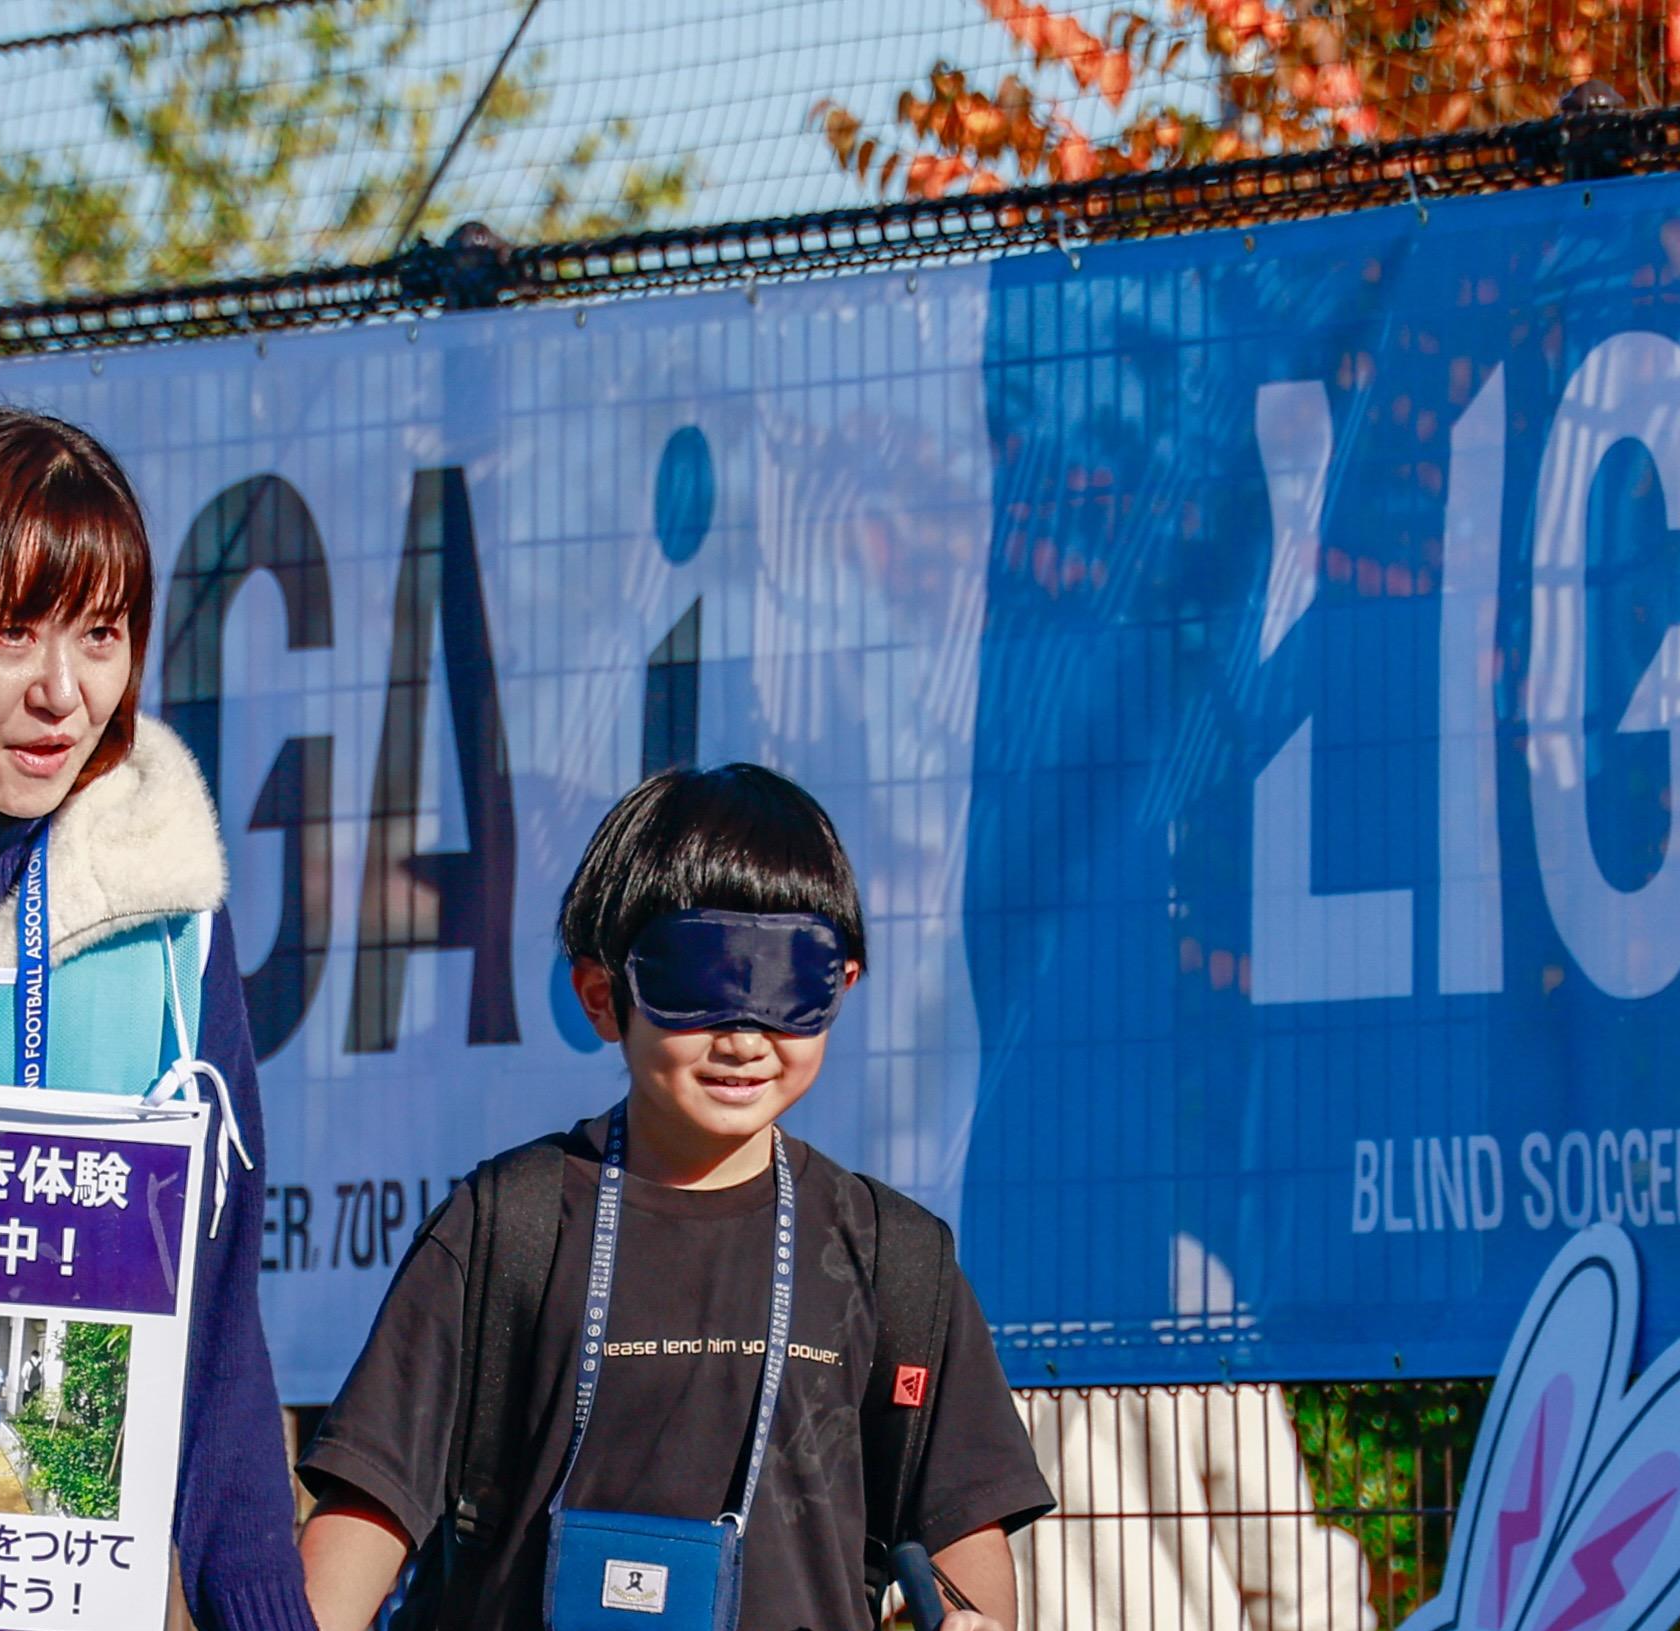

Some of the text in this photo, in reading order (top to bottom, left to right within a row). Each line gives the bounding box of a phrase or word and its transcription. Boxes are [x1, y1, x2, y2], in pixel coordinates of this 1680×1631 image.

[24, 848, 42, 959] ASSOCIATION
[24, 965, 43, 1058] FOOTBALL
[332, 1179, 406, 1269] TOP
[1351, 1134, 1504, 1233] BLIND
[603, 1338, 843, 1367] lease lend him yo power.
